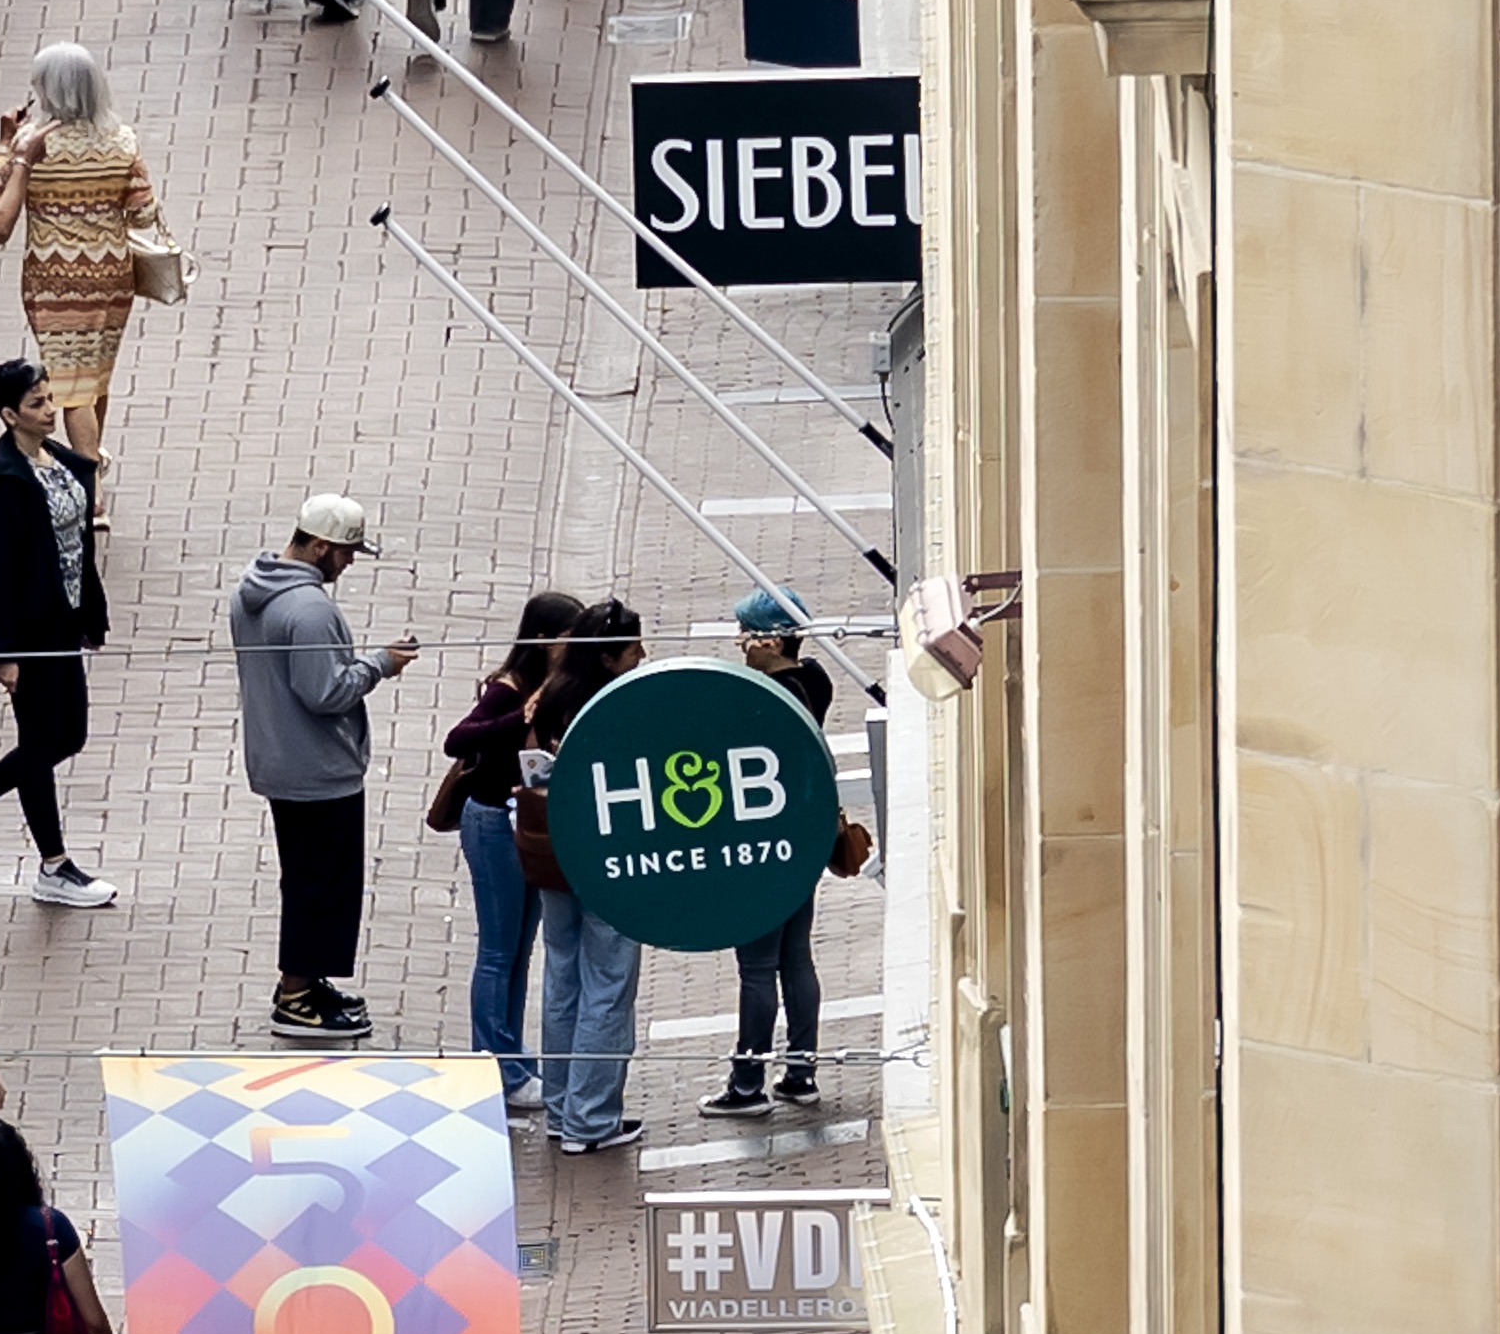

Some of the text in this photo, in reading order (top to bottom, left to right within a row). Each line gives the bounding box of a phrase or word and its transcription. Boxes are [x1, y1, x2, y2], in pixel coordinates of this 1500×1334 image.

[592, 746, 787, 835] H&B
[605, 839, 793, 879] SINCE 1870
